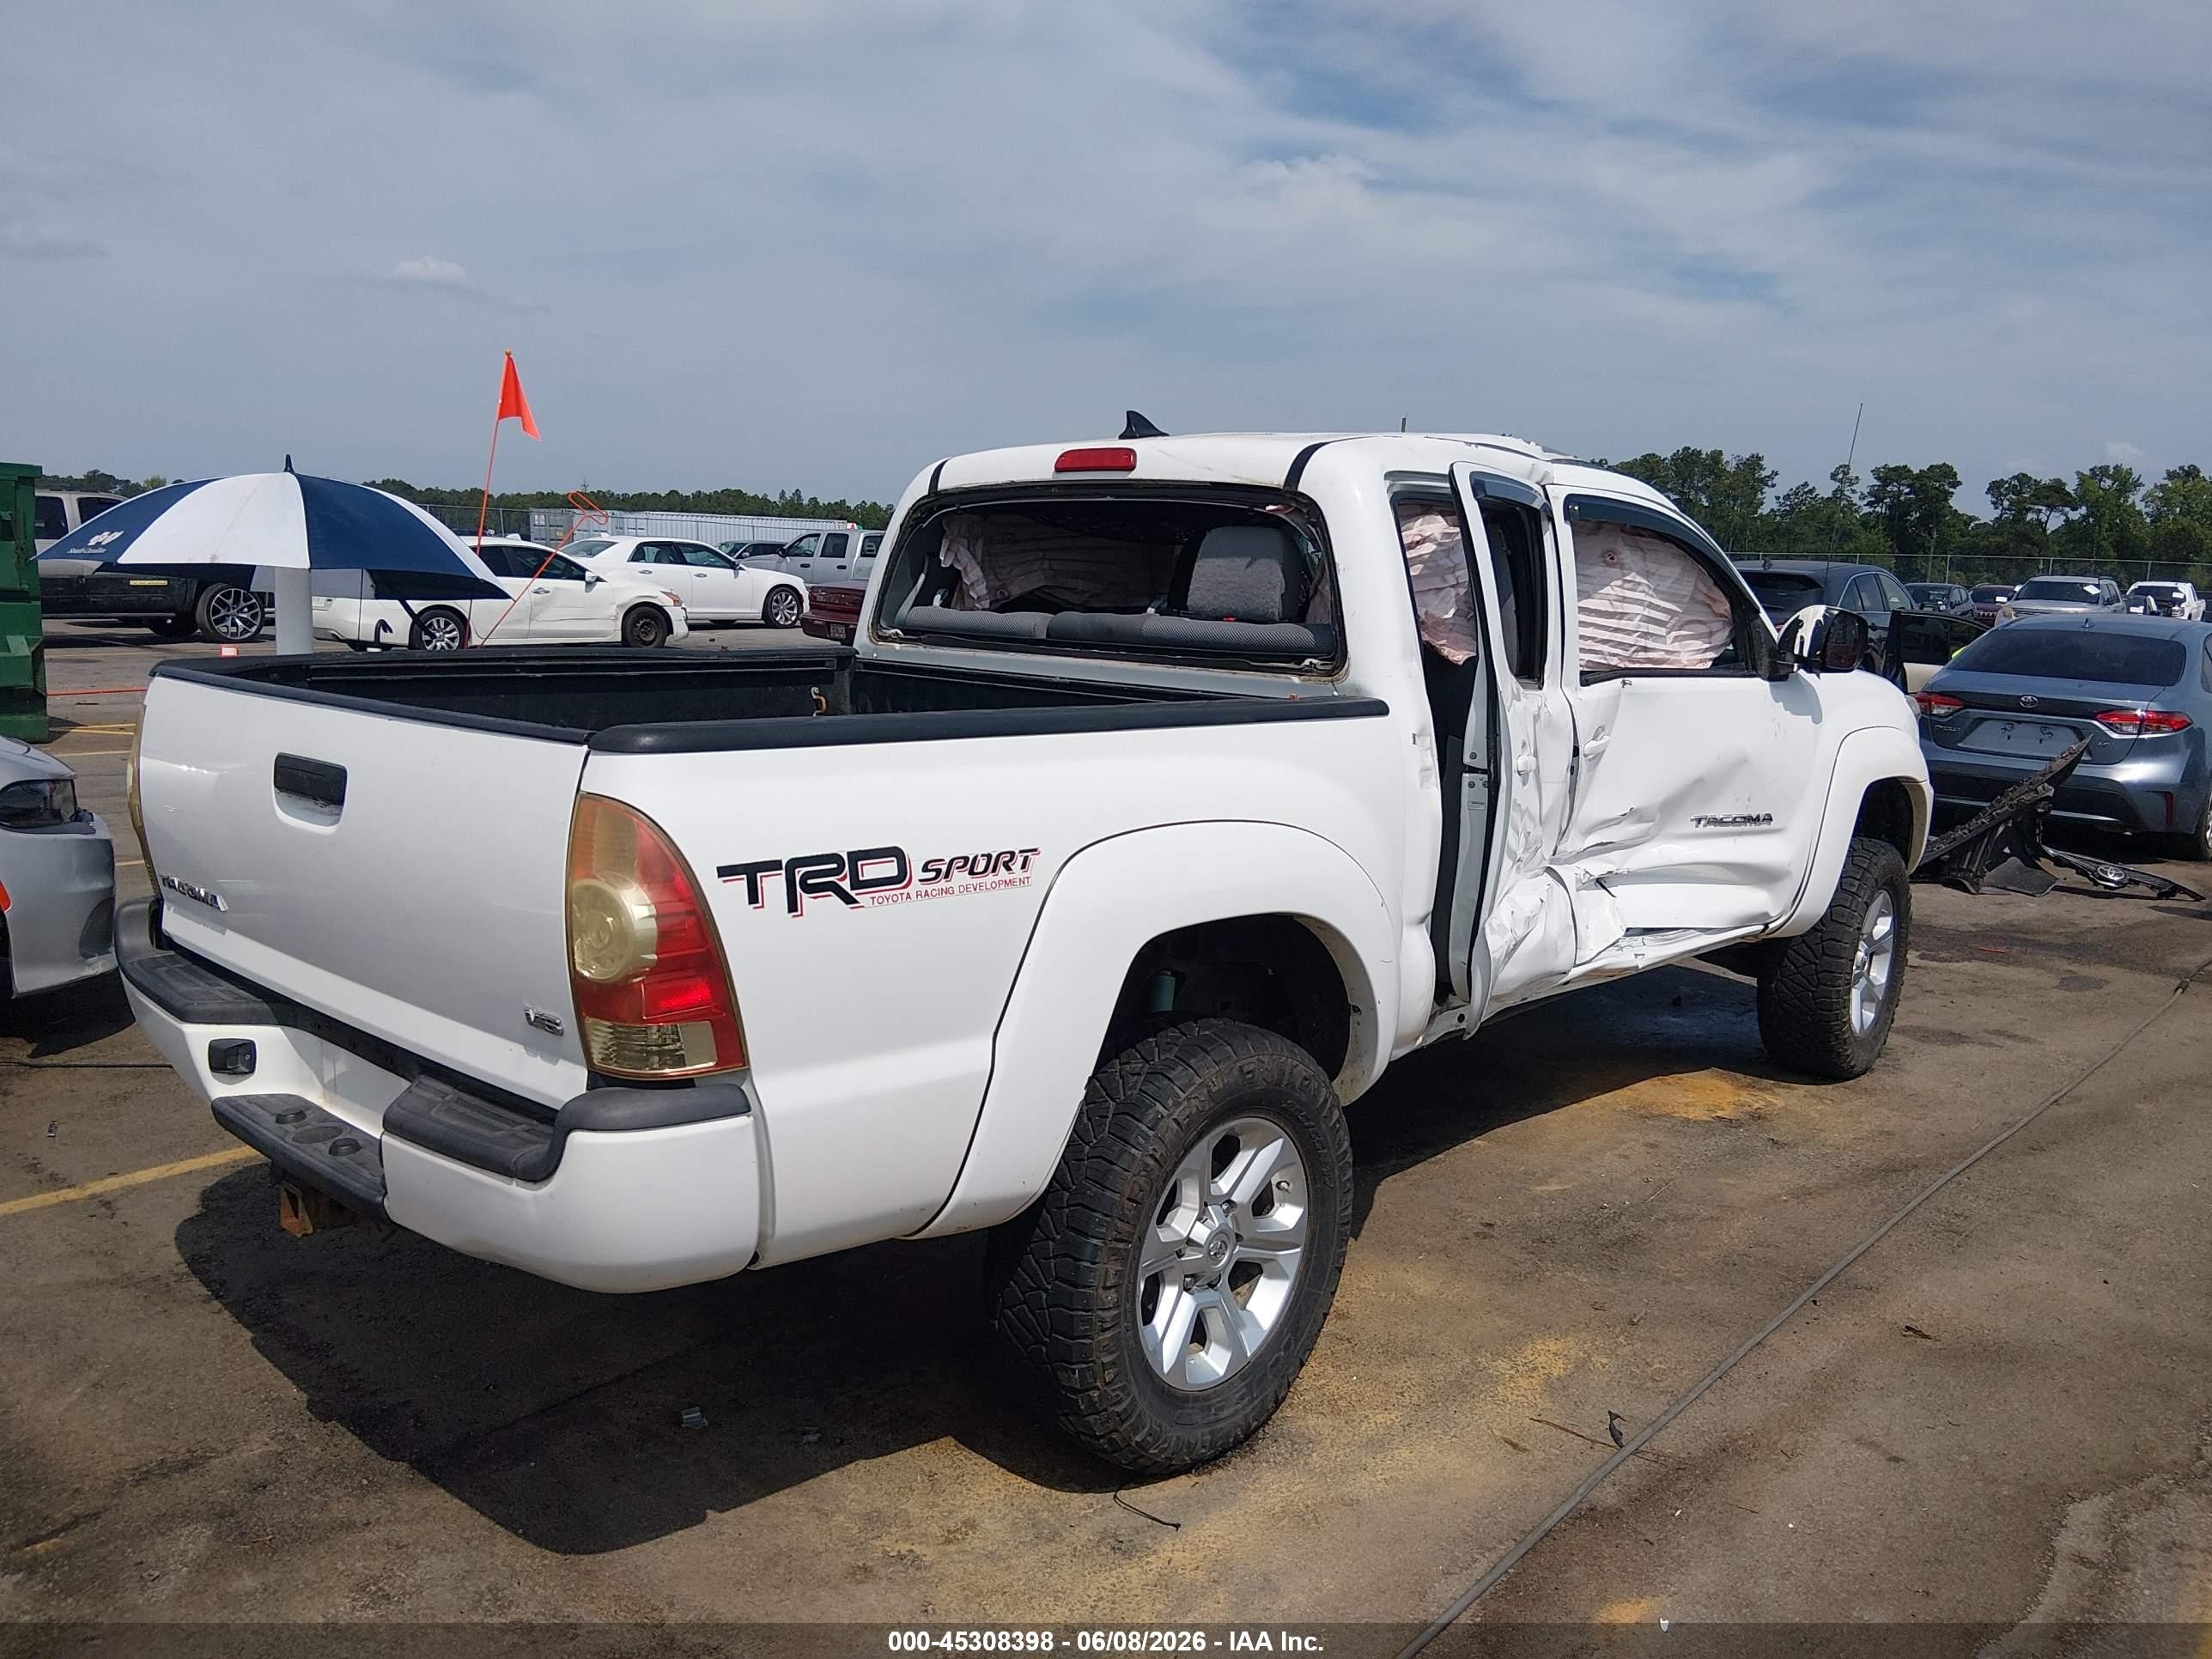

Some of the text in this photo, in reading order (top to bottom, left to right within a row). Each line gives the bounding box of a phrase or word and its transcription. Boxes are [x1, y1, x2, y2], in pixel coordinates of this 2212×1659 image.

[1690, 812, 1773, 827] TACOMA
[716, 846, 1041, 918] TRD SPORT
[871, 876, 1031, 906] TOYOTA RACING DEVELOPMENT
